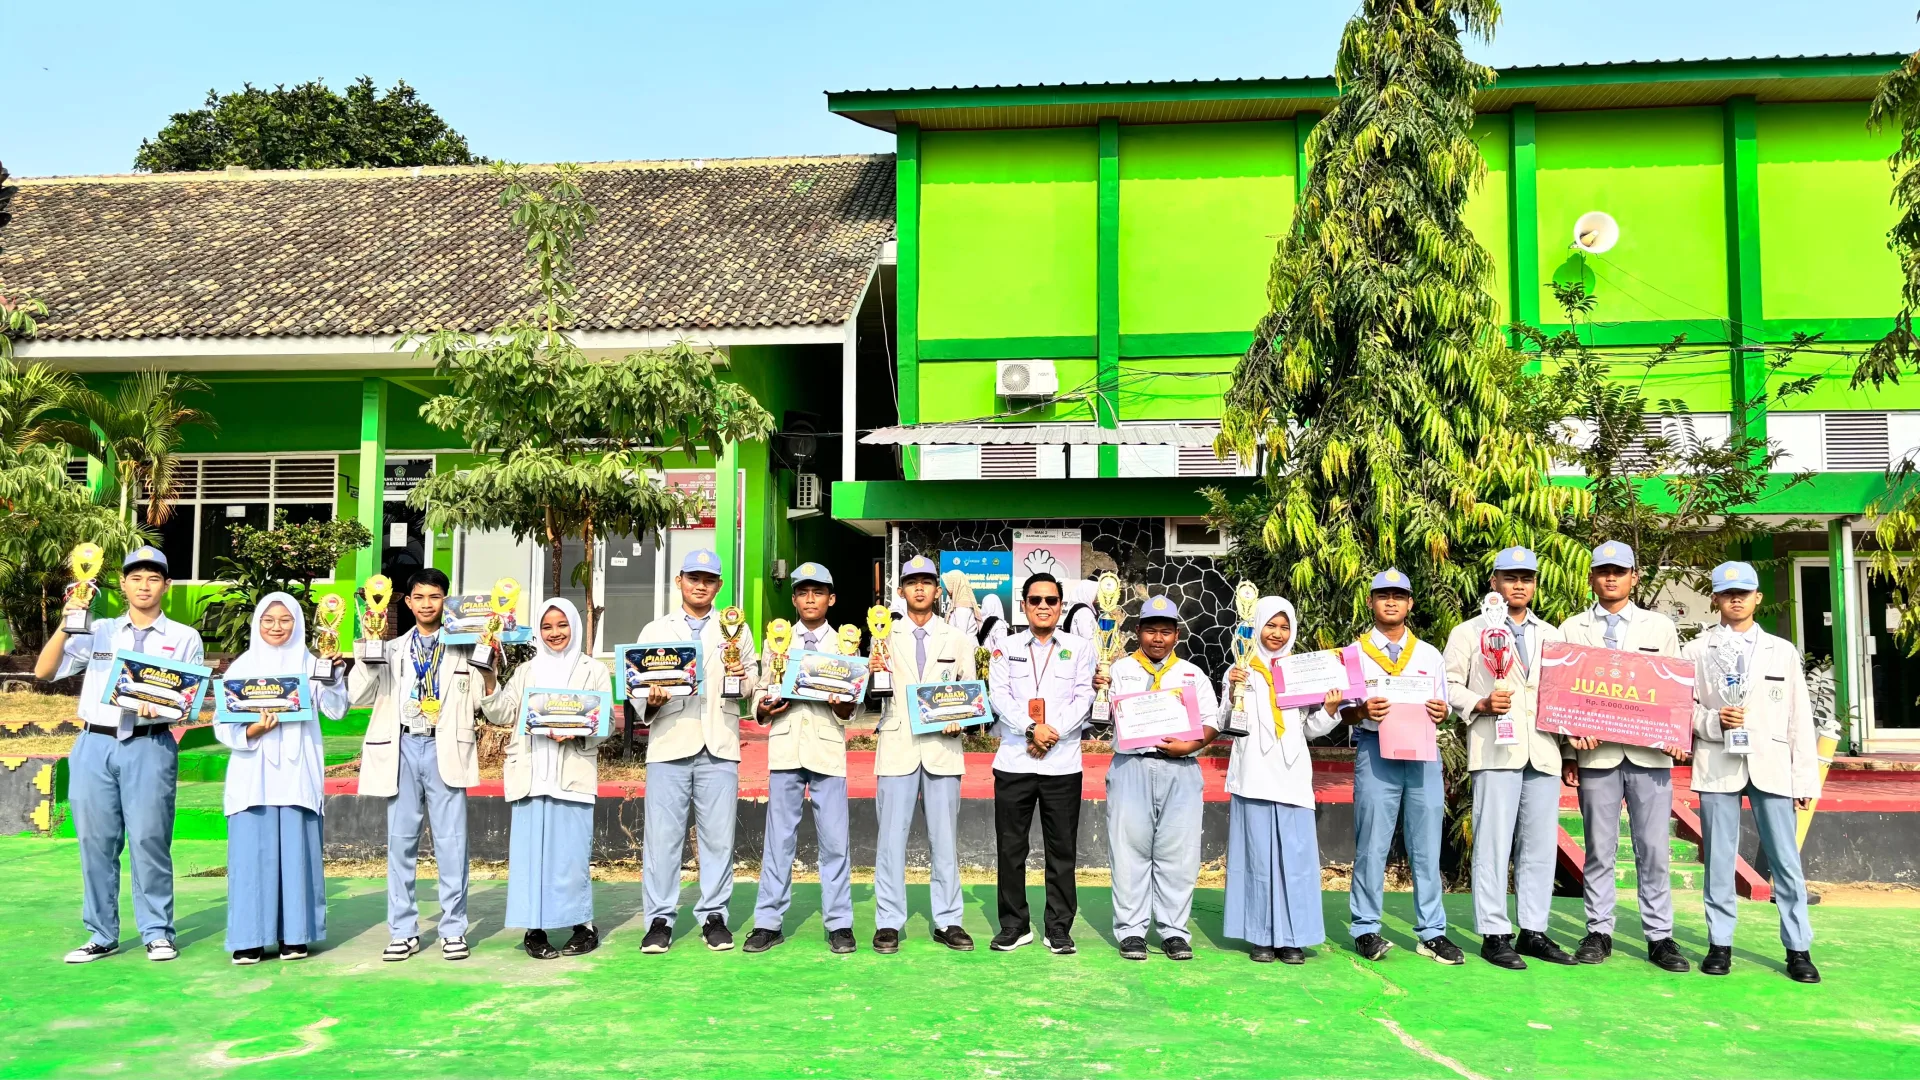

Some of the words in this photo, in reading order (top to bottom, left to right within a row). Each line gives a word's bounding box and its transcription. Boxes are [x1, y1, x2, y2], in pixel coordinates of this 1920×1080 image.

[645, 654, 678, 662] PIAGAM
[818, 664, 849, 674] PIAGAM
[143, 668, 180, 683] PIAGAM
[935, 691, 965, 699] PIAGAM
[1570, 678, 1640, 700] JUARA
[1648, 688, 1656, 703] 1
[1587, 712, 1616, 720] BERBARIS
[1636, 718, 1668, 728] PANGLIMA
[1602, 720, 1640, 730] PERINGATAN
[1546, 718, 1572, 726] TENTARA
[1574, 722, 1604, 730] NASIONAL
[1606, 726, 1640, 736] INDONESIA
